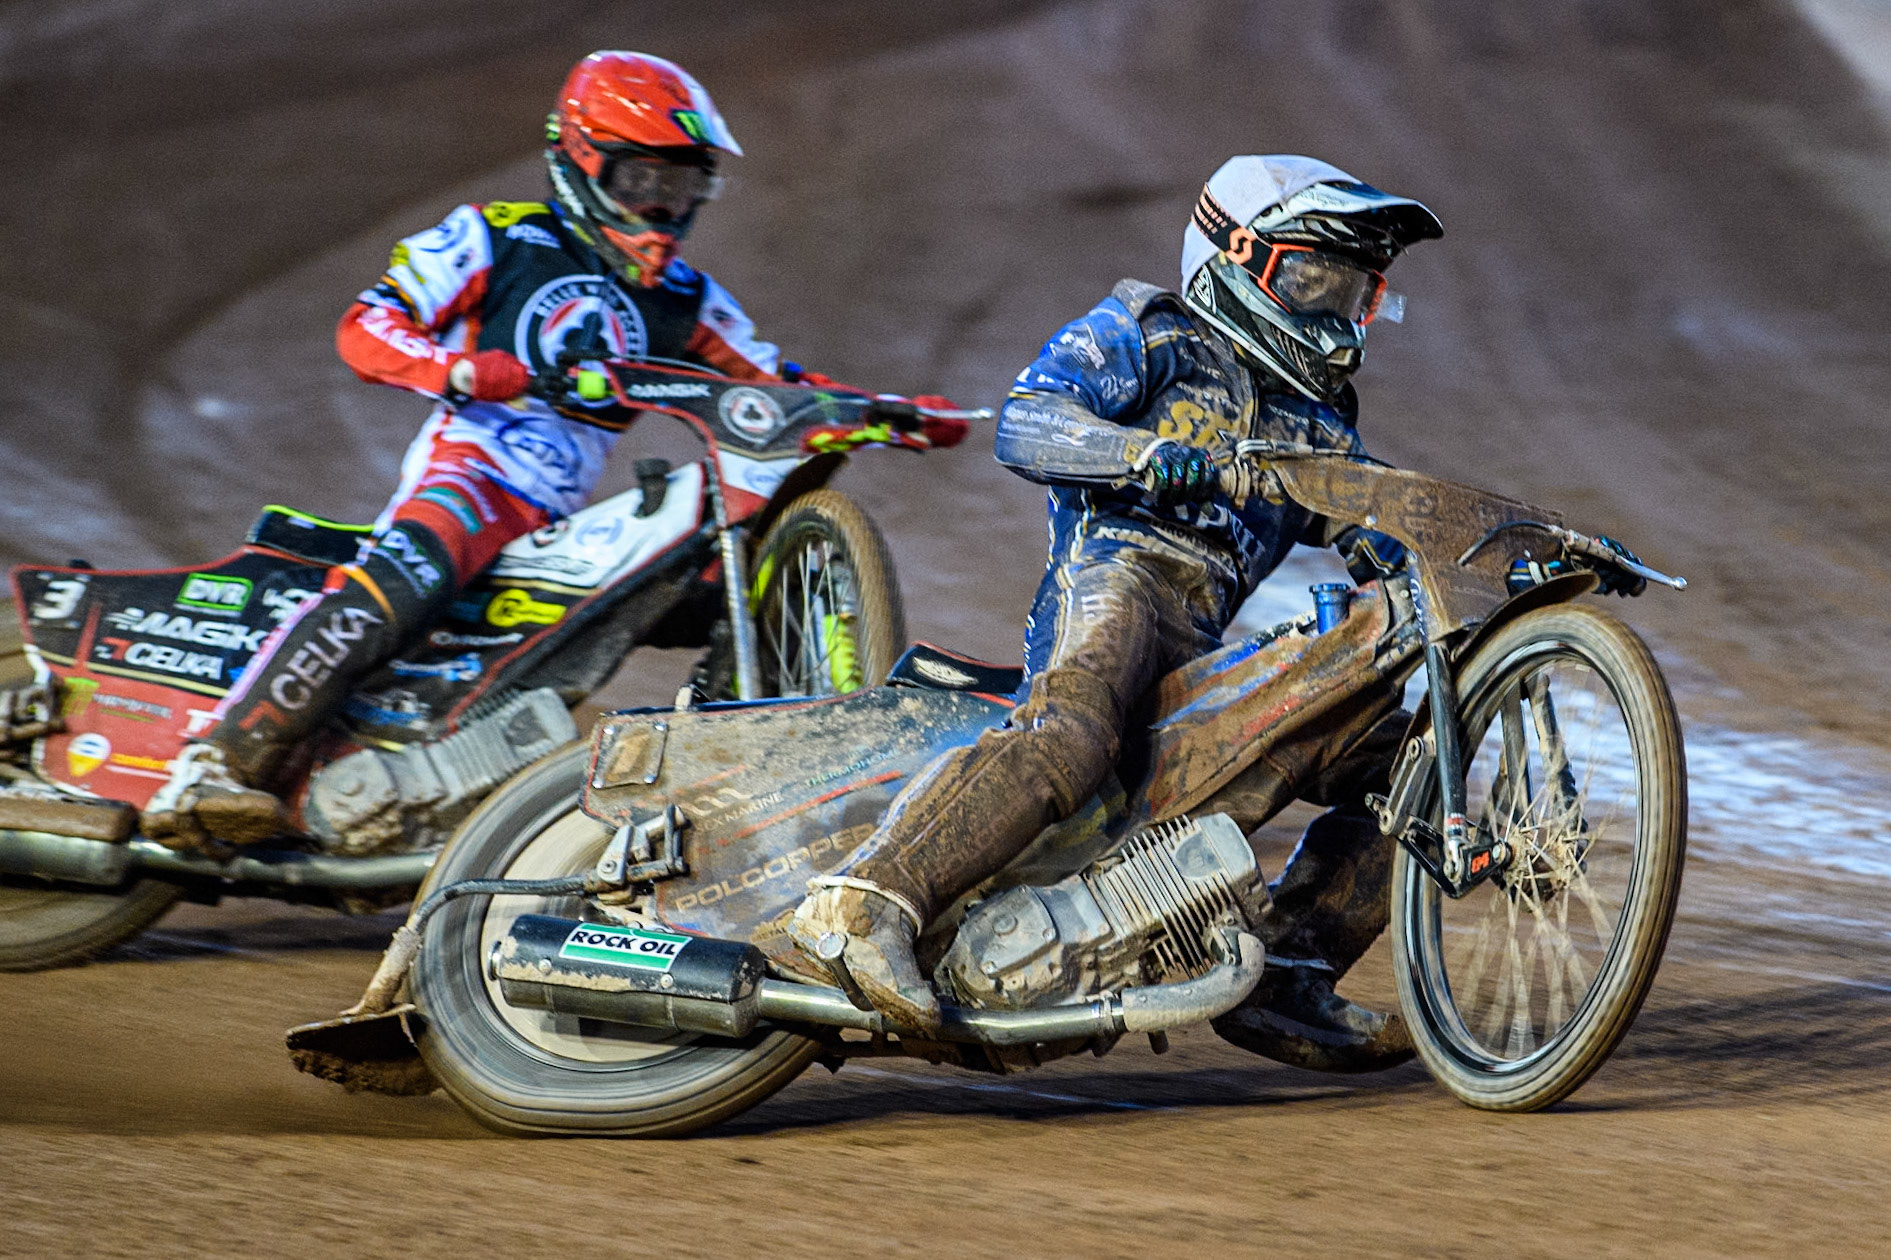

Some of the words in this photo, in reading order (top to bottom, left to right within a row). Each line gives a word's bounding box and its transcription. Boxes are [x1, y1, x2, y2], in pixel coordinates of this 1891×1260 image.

[34, 580, 87, 619] 3
[271, 607, 383, 710] CELKA
[675, 822, 876, 913] POLCOPPER
[570, 931, 637, 950] ROCK
[639, 940, 676, 956] OIL
